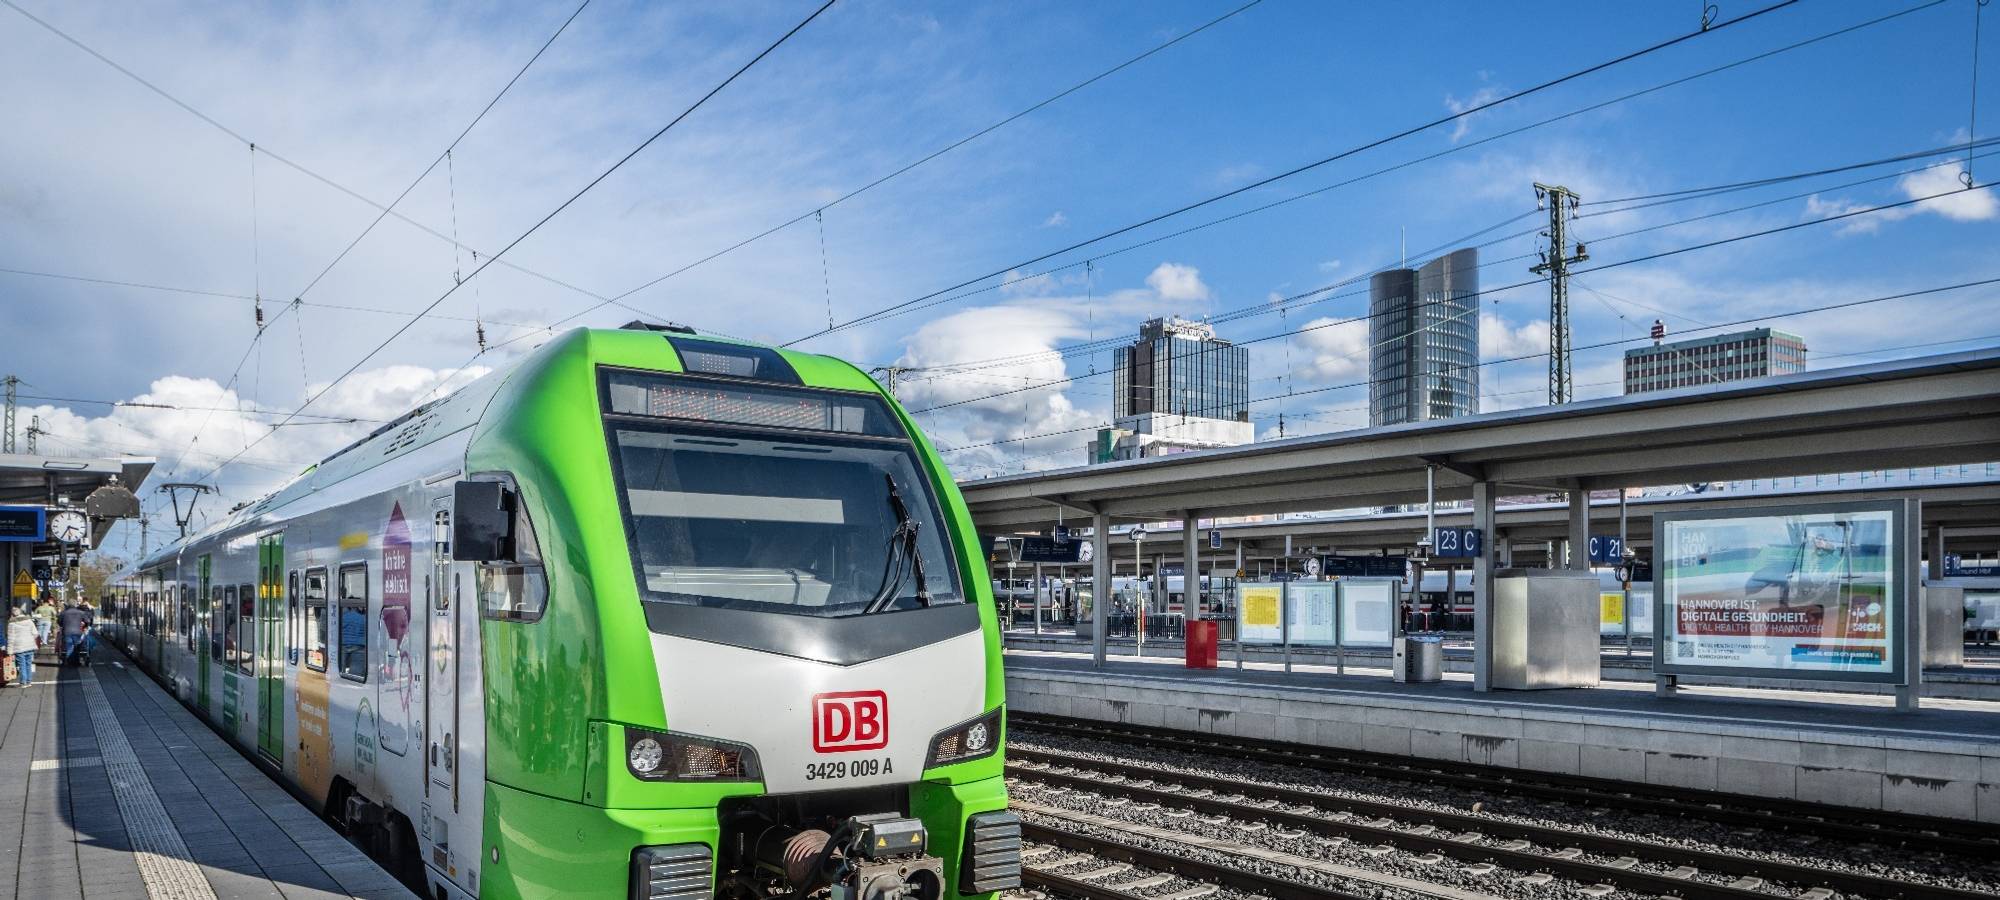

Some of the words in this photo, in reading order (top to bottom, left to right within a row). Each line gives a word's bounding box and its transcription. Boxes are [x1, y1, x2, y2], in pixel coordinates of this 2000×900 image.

[1441, 530, 1457, 550] 23
[1464, 531, 1474, 550] C
[1589, 537, 1598, 556] C
[1609, 539, 1621, 557] 21
[1682, 555, 1698, 567] ER
[1945, 556, 1951, 569] E
[38, 569, 51, 579] 26
[1680, 599, 1739, 610] HANNOVER
[1740, 600, 1760, 610] IST:
[1681, 611, 1730, 621] DIGITALE
[1731, 611, 1809, 623] GESUNDHEIT.
[1681, 623, 1712, 631] DIGITAL
[1713, 623, 1748, 632] HEALTH
[1749, 624, 1770, 633] CITY
[1770, 624, 1825, 634] HANNOVER
[822, 700, 881, 744] DB
[806, 761, 846, 780] 3429
[850, 758, 879, 777] 009
[882, 757, 893, 774] A
